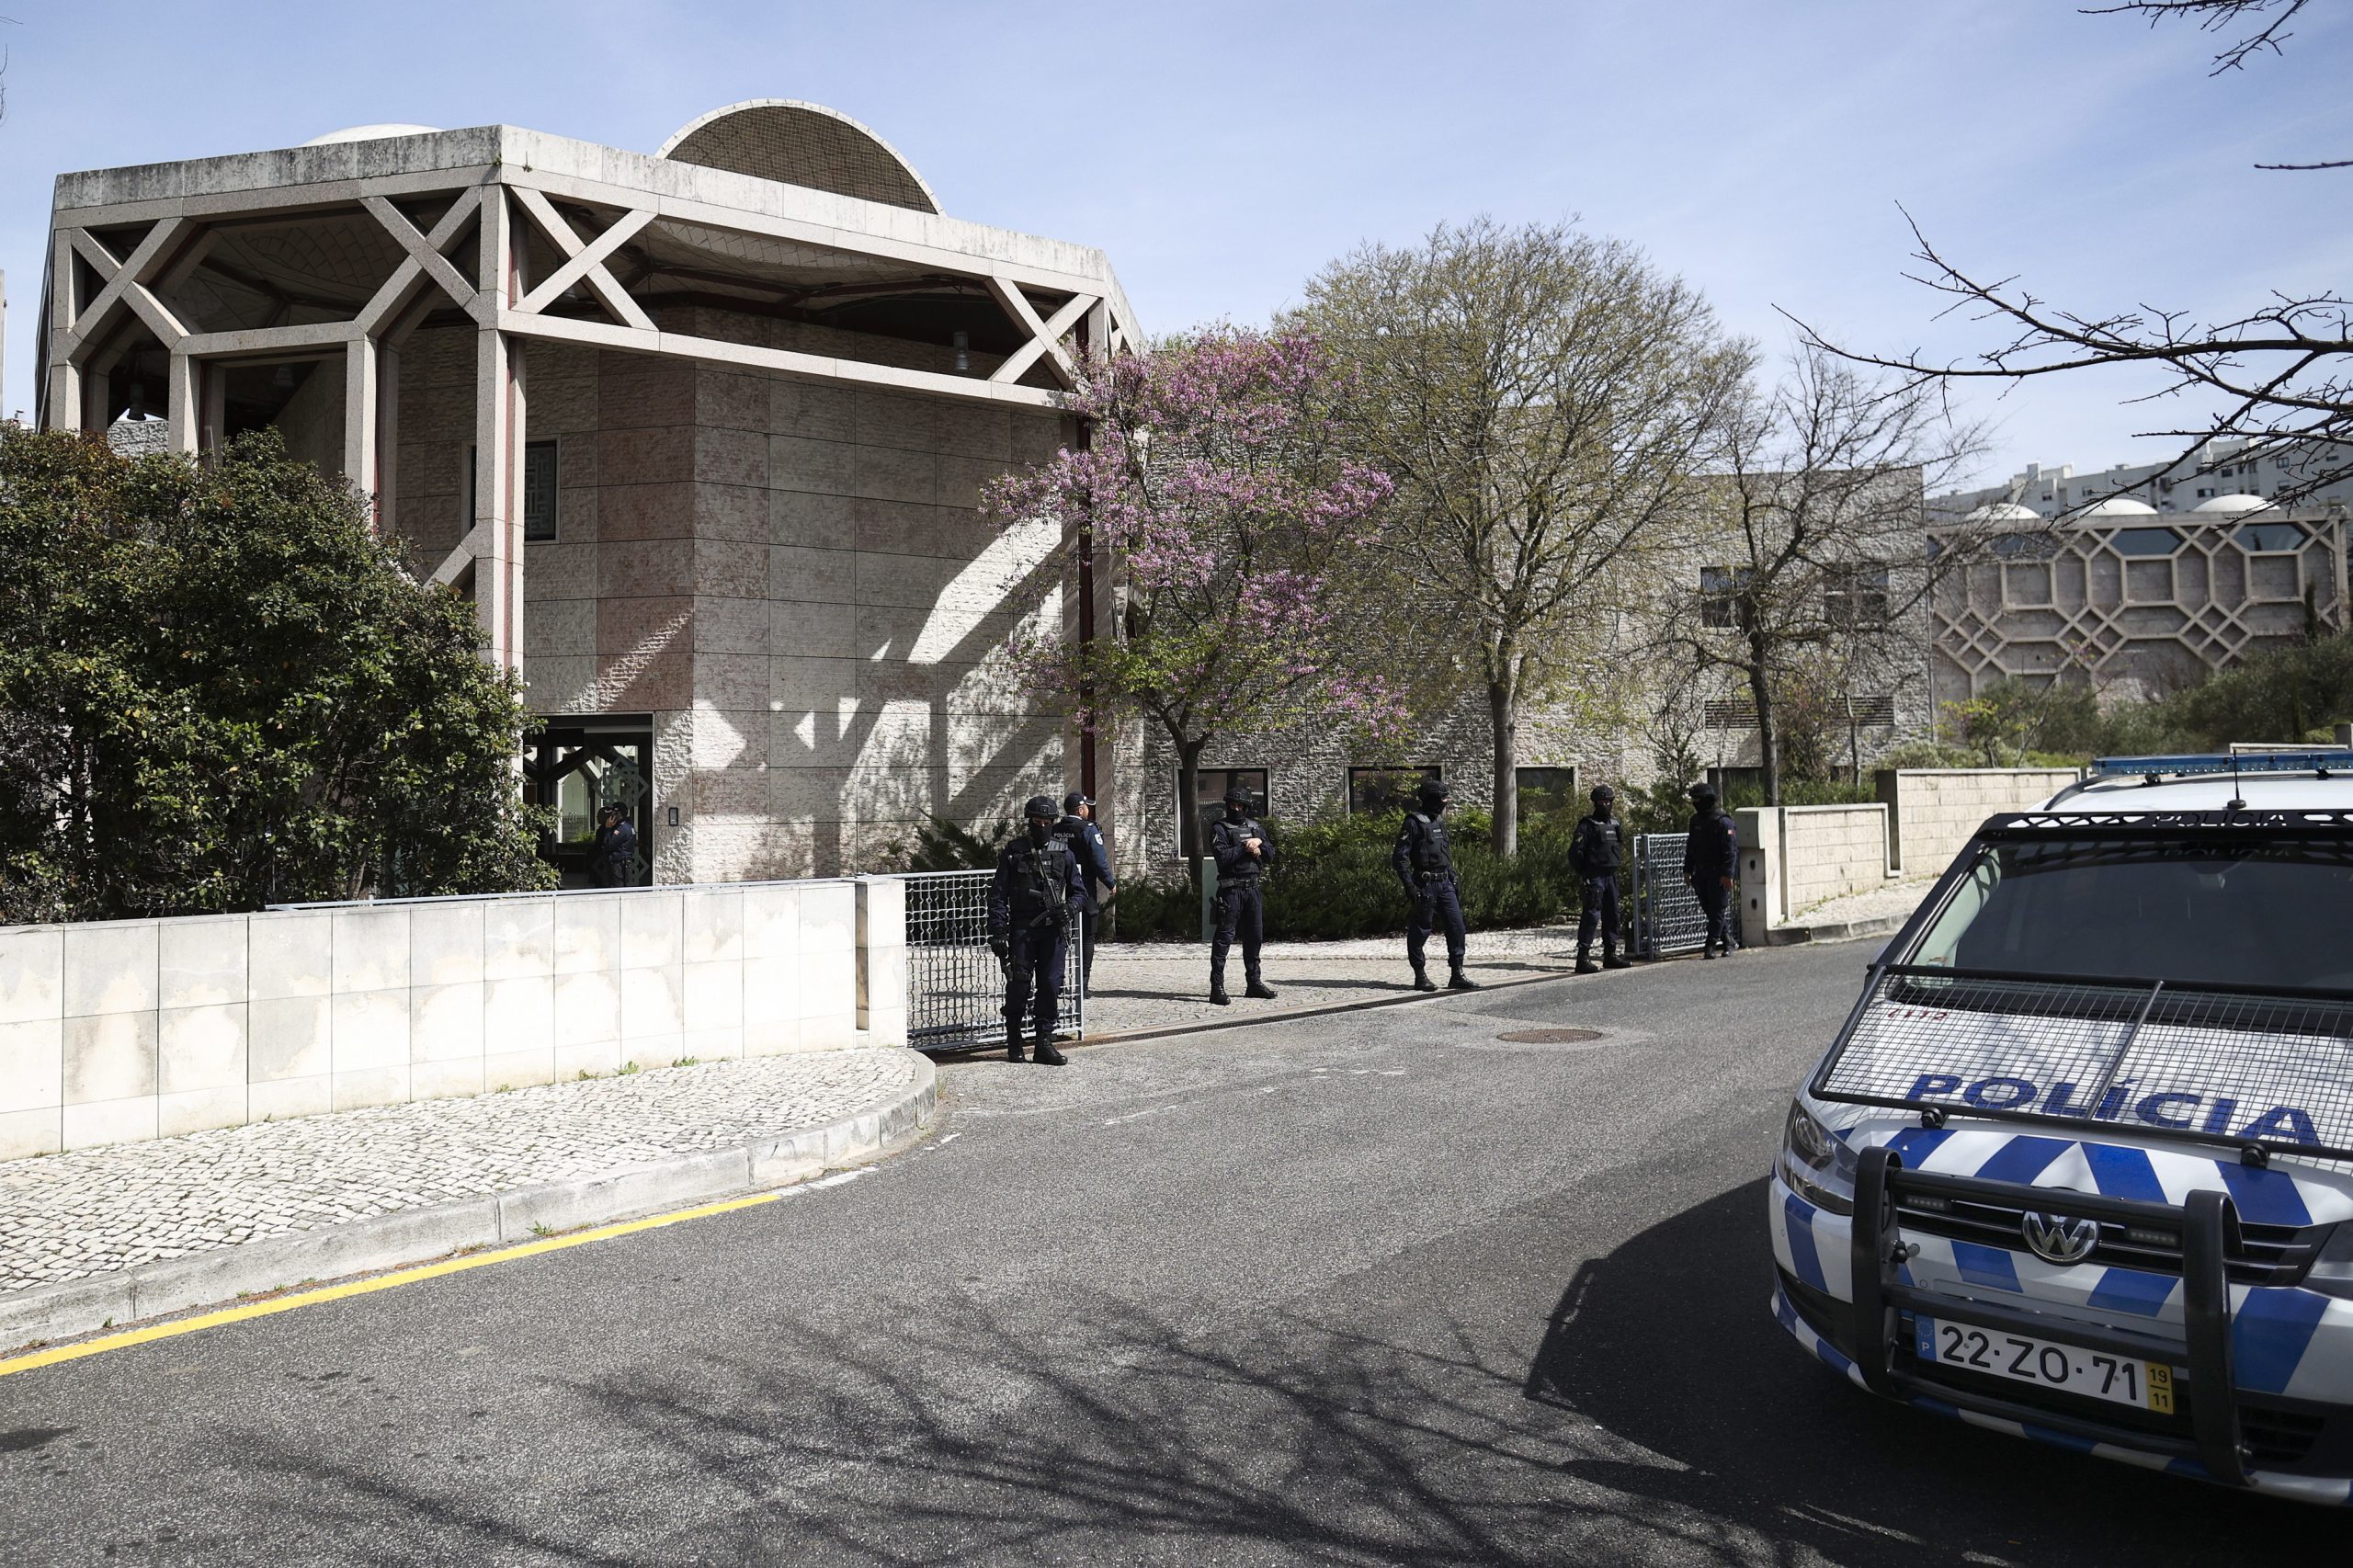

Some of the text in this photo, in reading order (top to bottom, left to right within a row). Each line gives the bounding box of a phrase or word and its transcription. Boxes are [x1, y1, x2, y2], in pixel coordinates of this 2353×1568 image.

[1904, 1074, 2322, 1147] POLÍCIA
[1921, 1342, 1930, 1352] P
[2149, 1368, 2168, 1384] 19
[2153, 1392, 2168, 1408] 11
